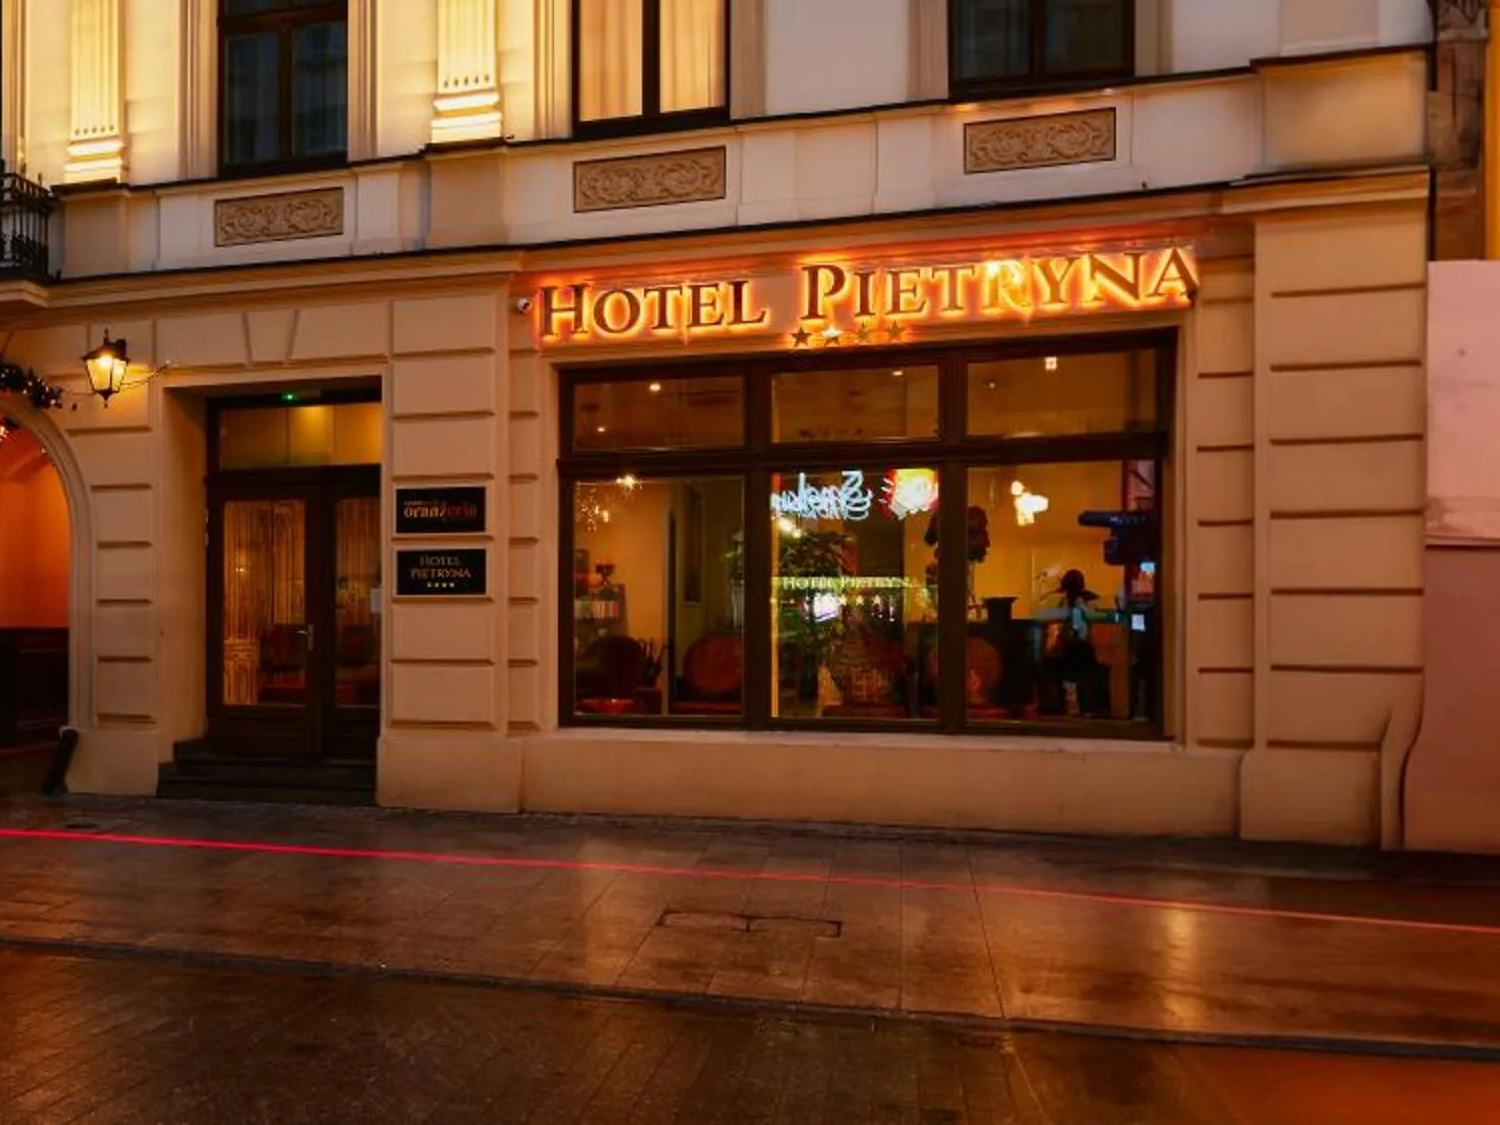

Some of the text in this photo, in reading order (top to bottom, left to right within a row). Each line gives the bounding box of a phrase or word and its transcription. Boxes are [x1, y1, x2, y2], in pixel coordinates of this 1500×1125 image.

[539, 246, 1199, 338] HOTEL PIETRYNA
[420, 555, 460, 566] HOTEL
